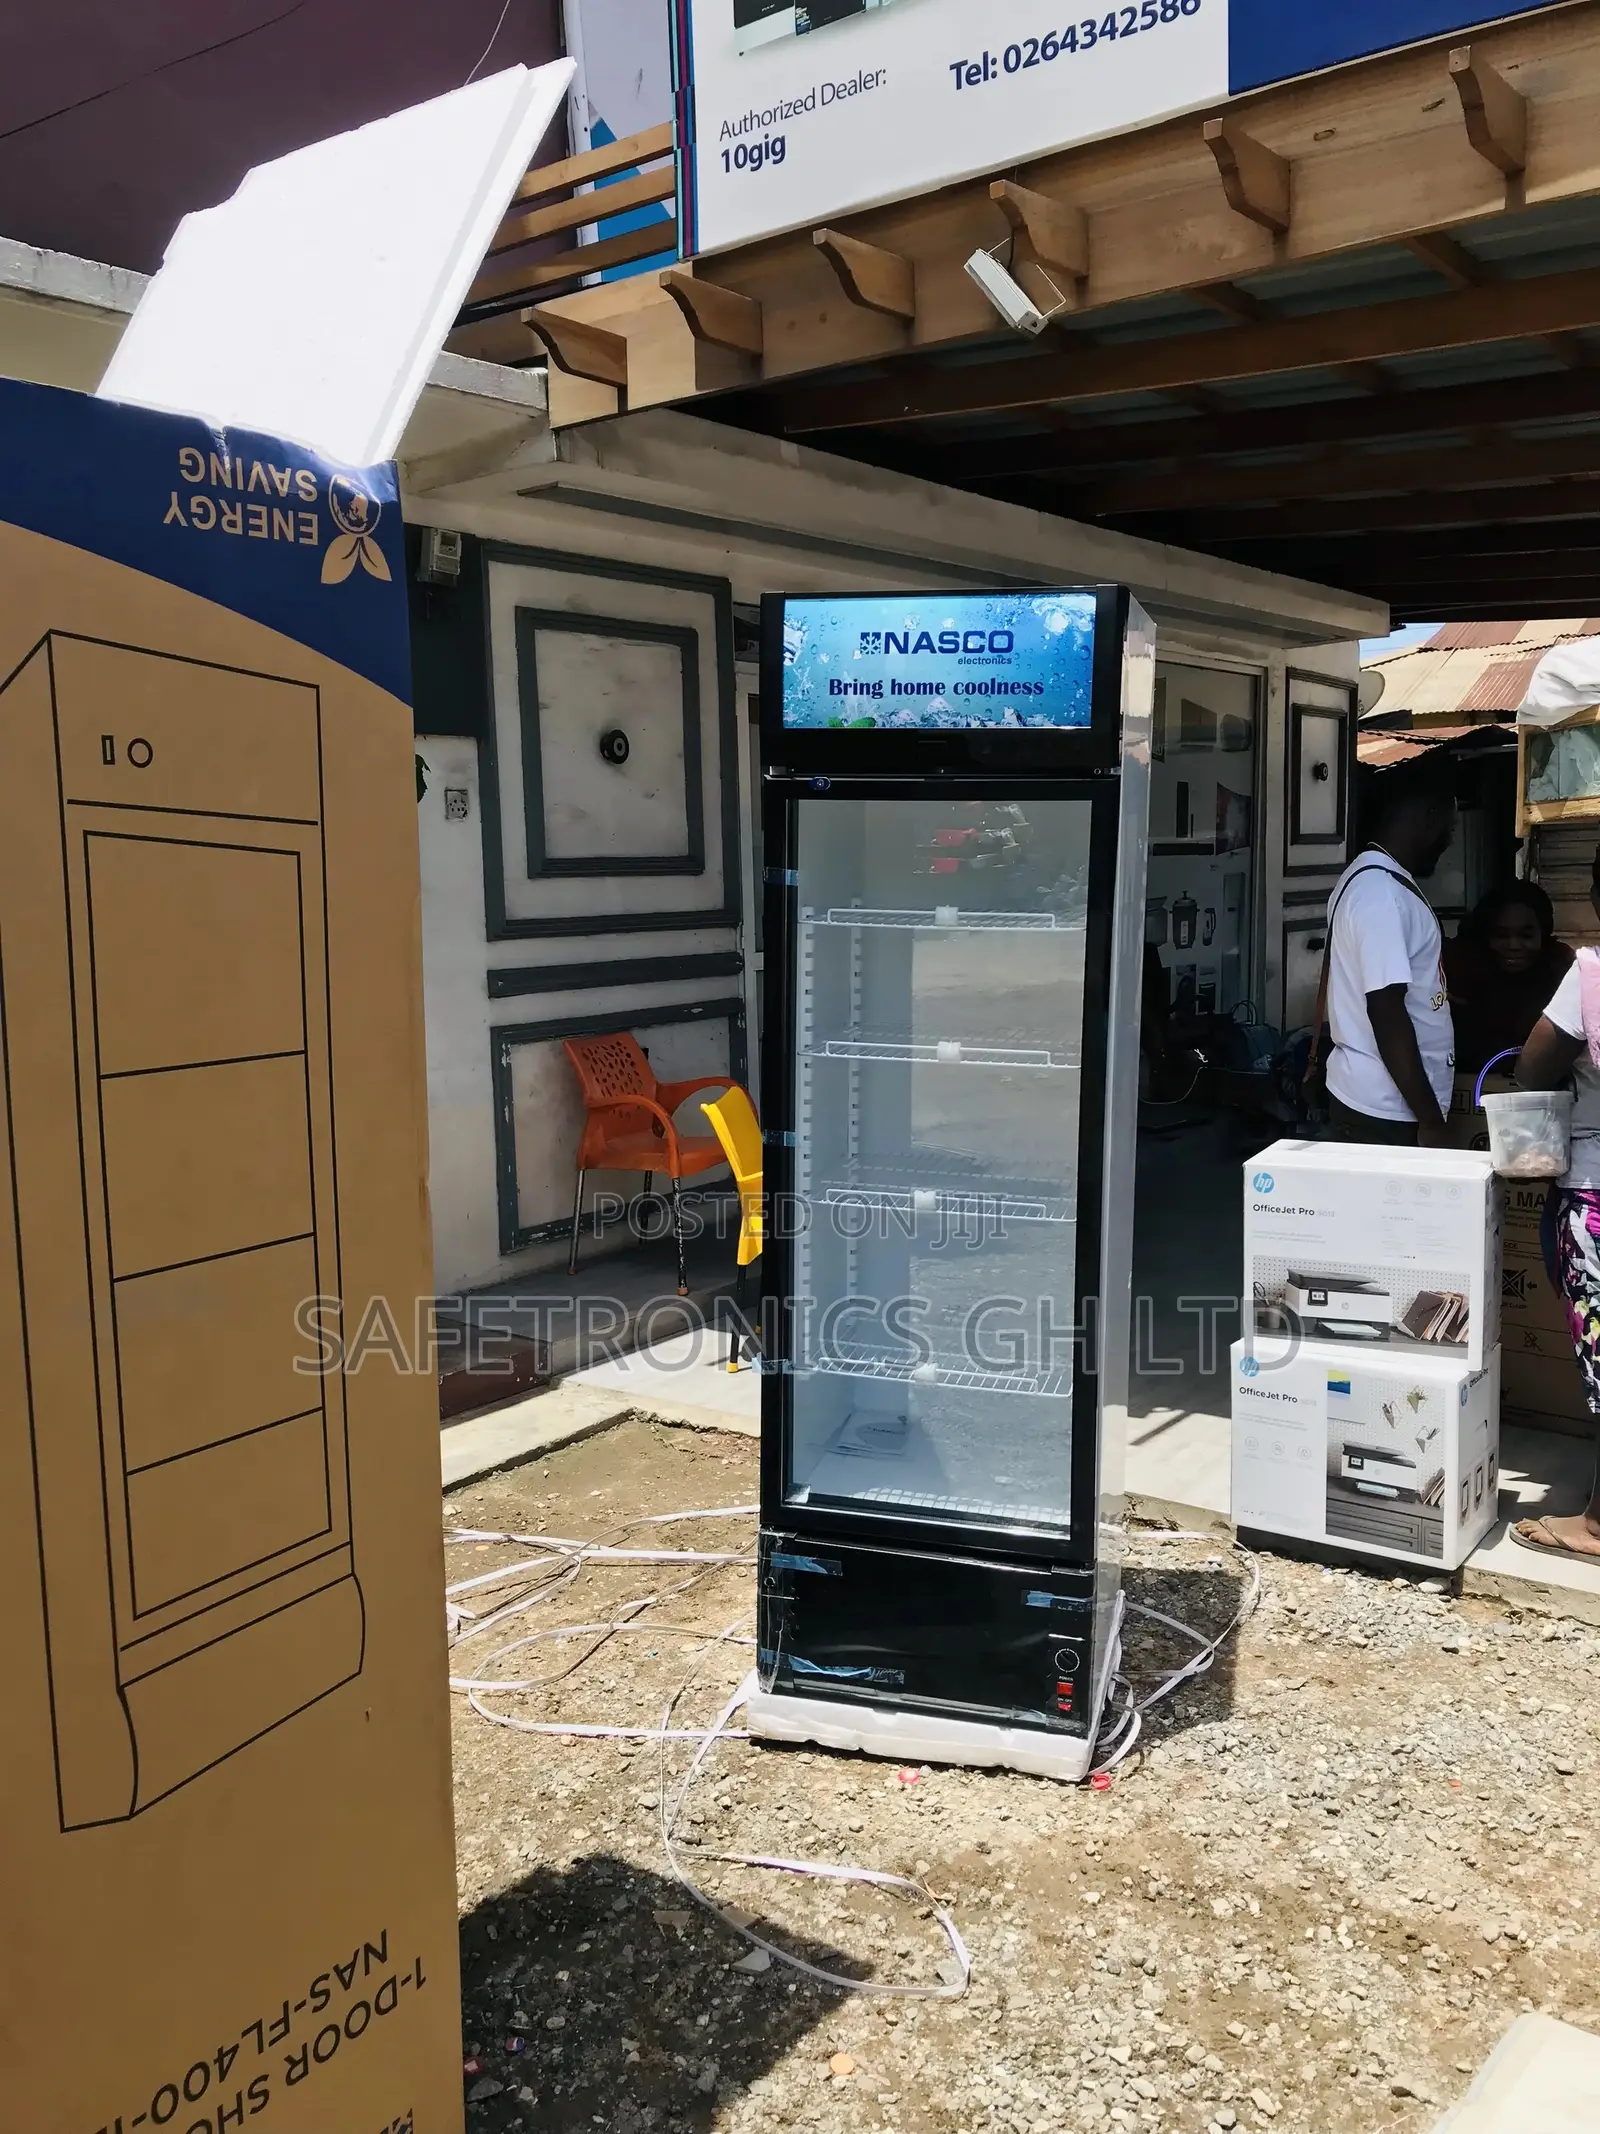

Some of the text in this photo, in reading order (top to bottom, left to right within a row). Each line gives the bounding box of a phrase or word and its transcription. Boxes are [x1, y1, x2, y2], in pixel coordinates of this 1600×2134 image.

[949, 51, 998, 90] Tel:
[719, 67, 887, 141] Authorized Dealer:
[720, 132, 787, 174] 10gig
[179, 447, 318, 502] SAVING
[163, 492, 319, 545] ENERGY
[883, 631, 1014, 654] NASCO
[957, 656, 1013, 665] electronics
[829, 677, 1045, 699] Bring home coolness
[1254, 1172, 1274, 1193] hp
[1253, 1204, 1296, 1215] OfficeJet
[1299, 1207, 1315, 1216] Pro
[1239, 1386, 1279, 1401] OfficeJet
[1282, 1393, 1298, 1404] Pro
[94, 1929, 389, 2134] NAS-FL400-
[284, 1956, 428, 2086] 1-DOOR
